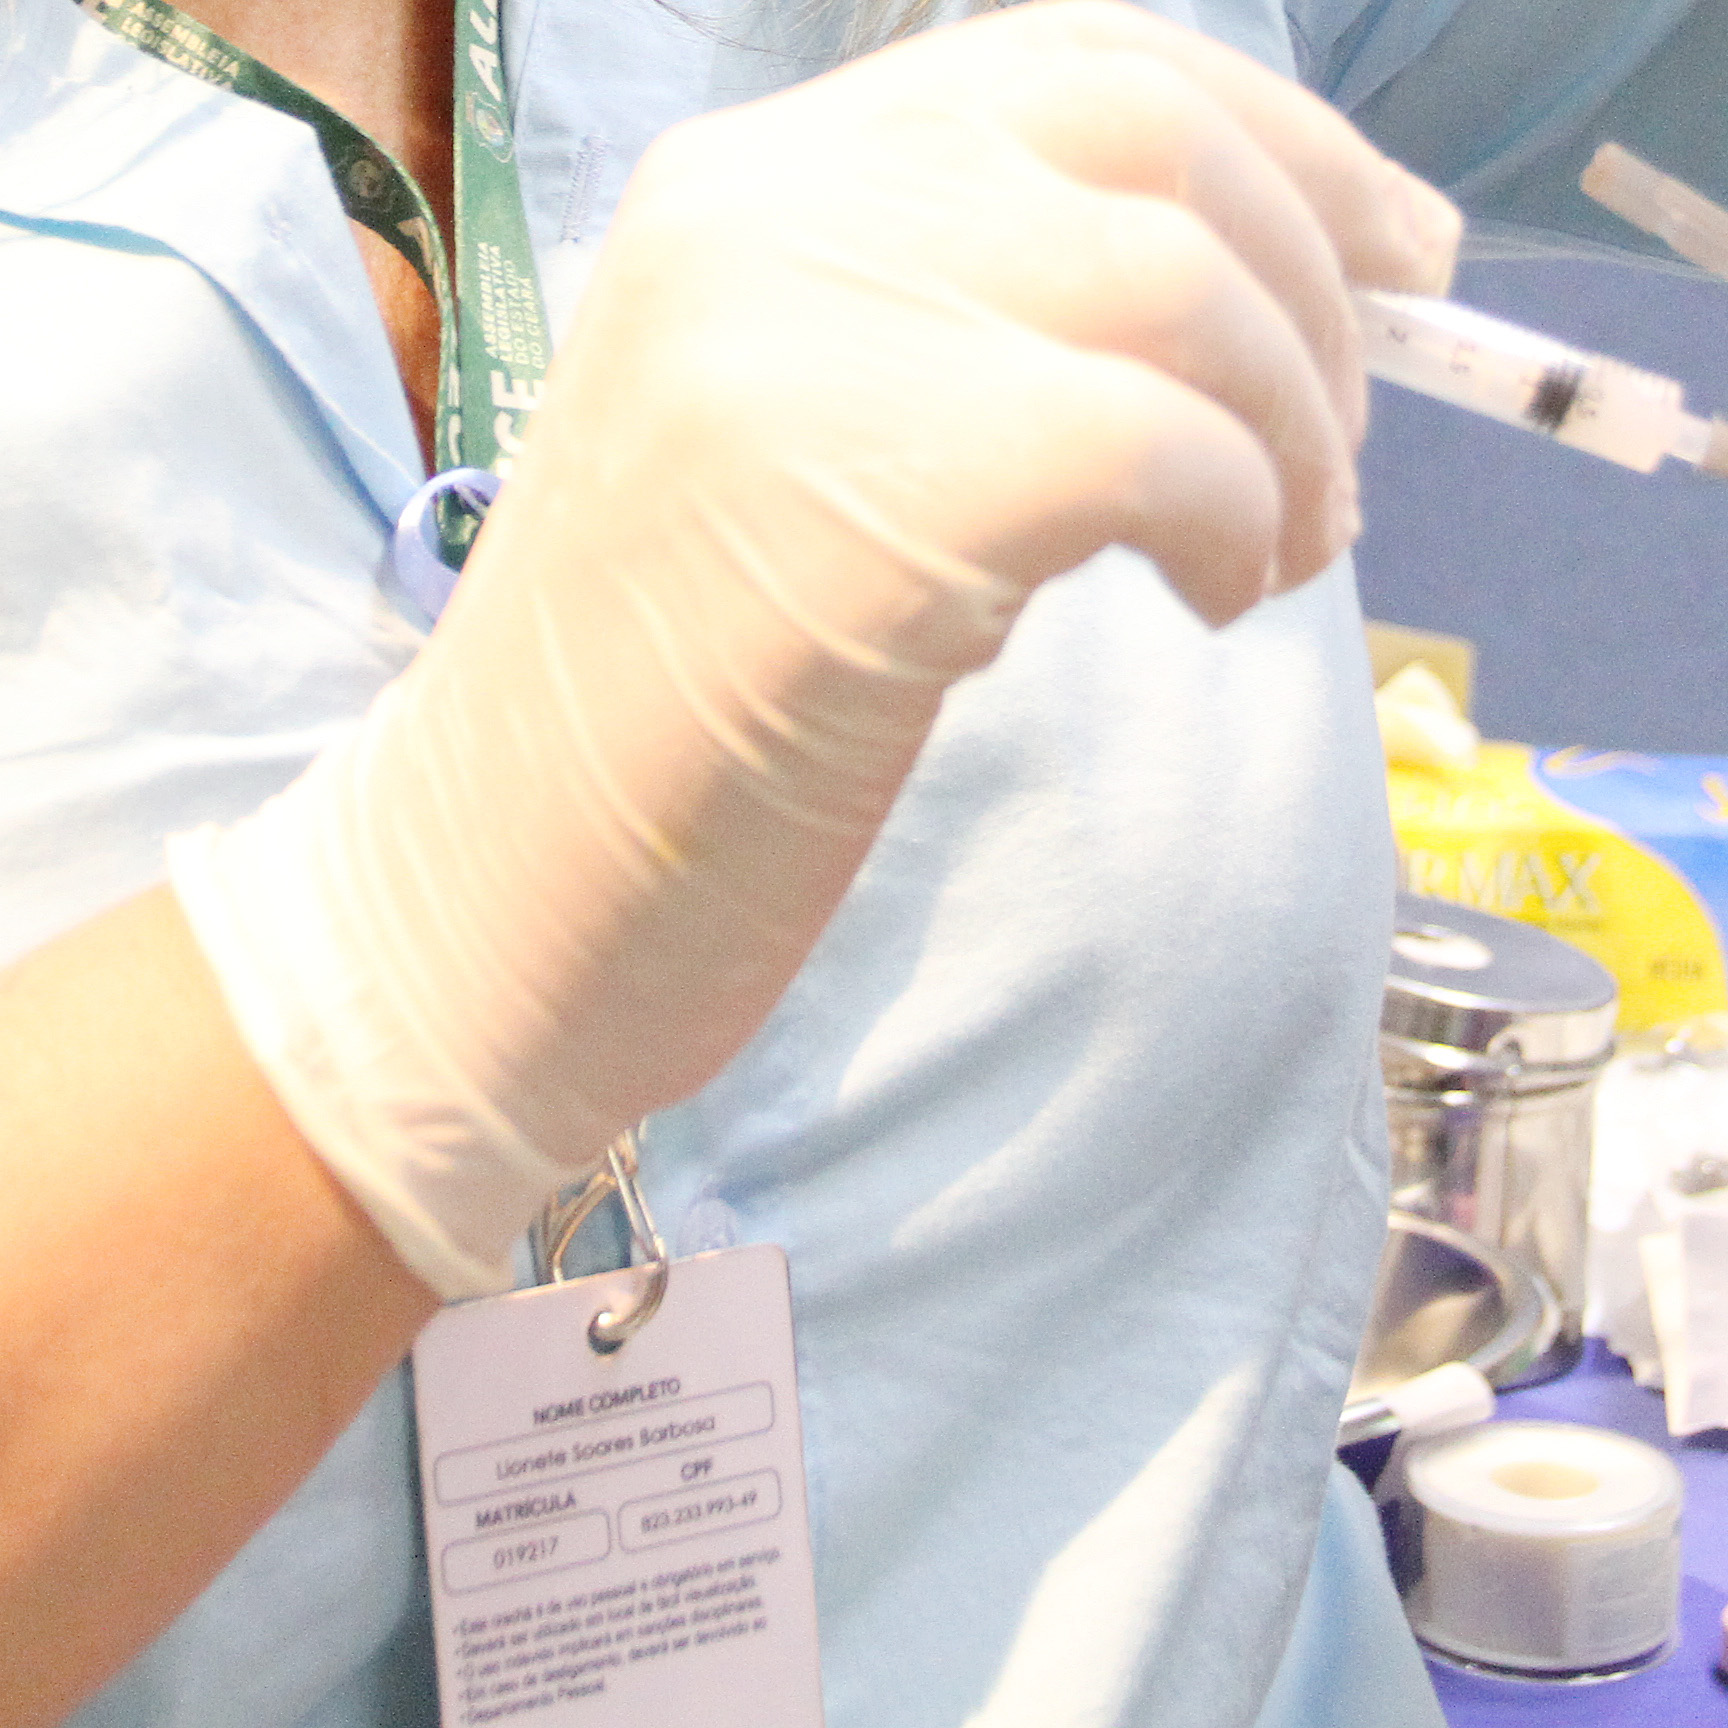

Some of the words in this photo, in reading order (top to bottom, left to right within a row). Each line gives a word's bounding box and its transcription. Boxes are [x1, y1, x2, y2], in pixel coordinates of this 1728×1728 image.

[477, 241, 498, 359] ASSEMBLEIA
[488, 245, 513, 363] LEGISLATIVA
[503, 259, 528, 333] ESTADO
[512, 336, 530, 366] DO
[530, 343, 547, 370] DO
[532, 1395, 584, 1425] NOME
[588, 1376, 682, 1414] COMPLETO
[572, 1434, 635, 1463] Soares
[639, 1415, 716, 1447] Barbosa
[679, 1456, 714, 1483] CPF
[474, 1489, 577, 1529] MATRÍCULA
[492, 1535, 560, 1570] 019217
